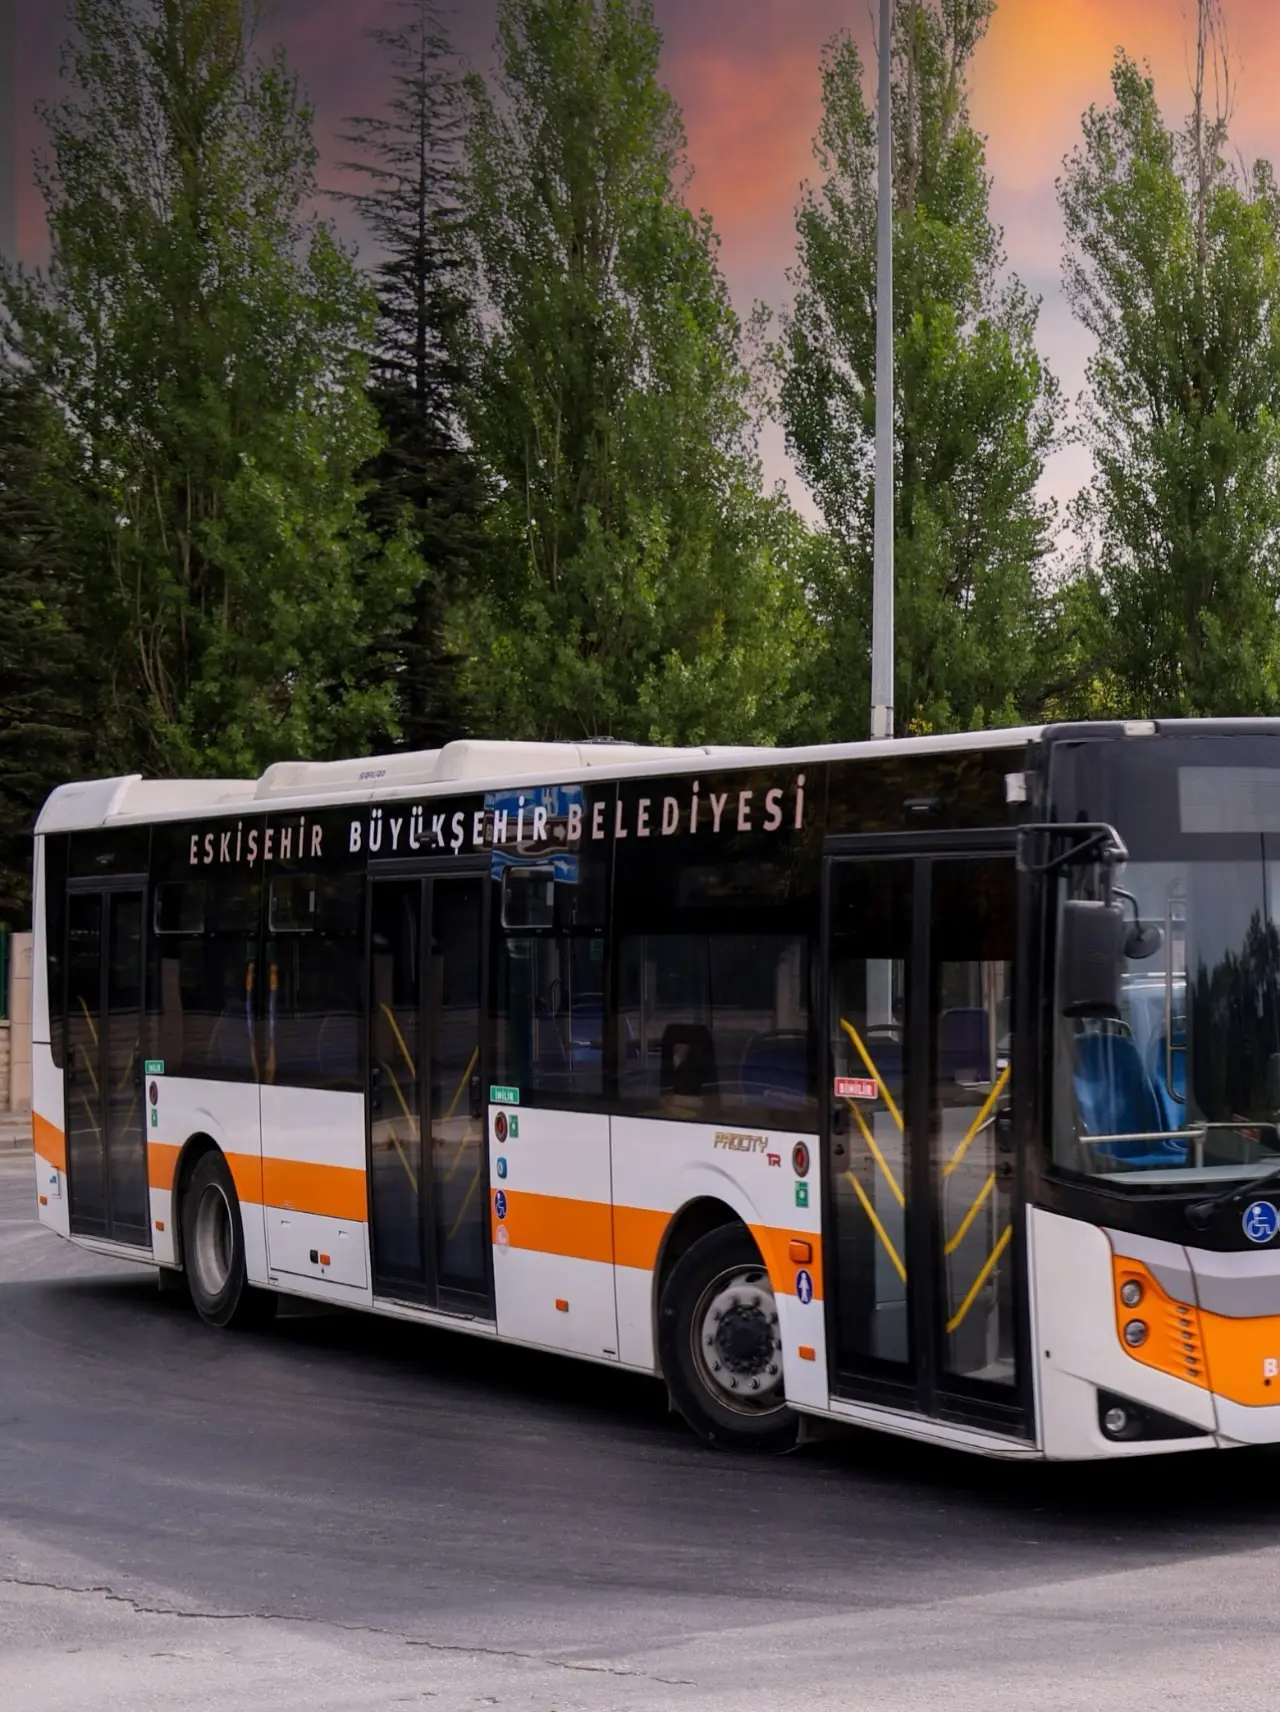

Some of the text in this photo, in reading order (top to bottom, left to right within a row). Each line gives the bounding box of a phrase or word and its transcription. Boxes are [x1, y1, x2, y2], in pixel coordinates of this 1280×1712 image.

[189, 774, 806, 868] ESKİŞEHİR BÜYÜKŞEHİR BELEDİYESİ
[767, 1153, 781, 1167] TR
